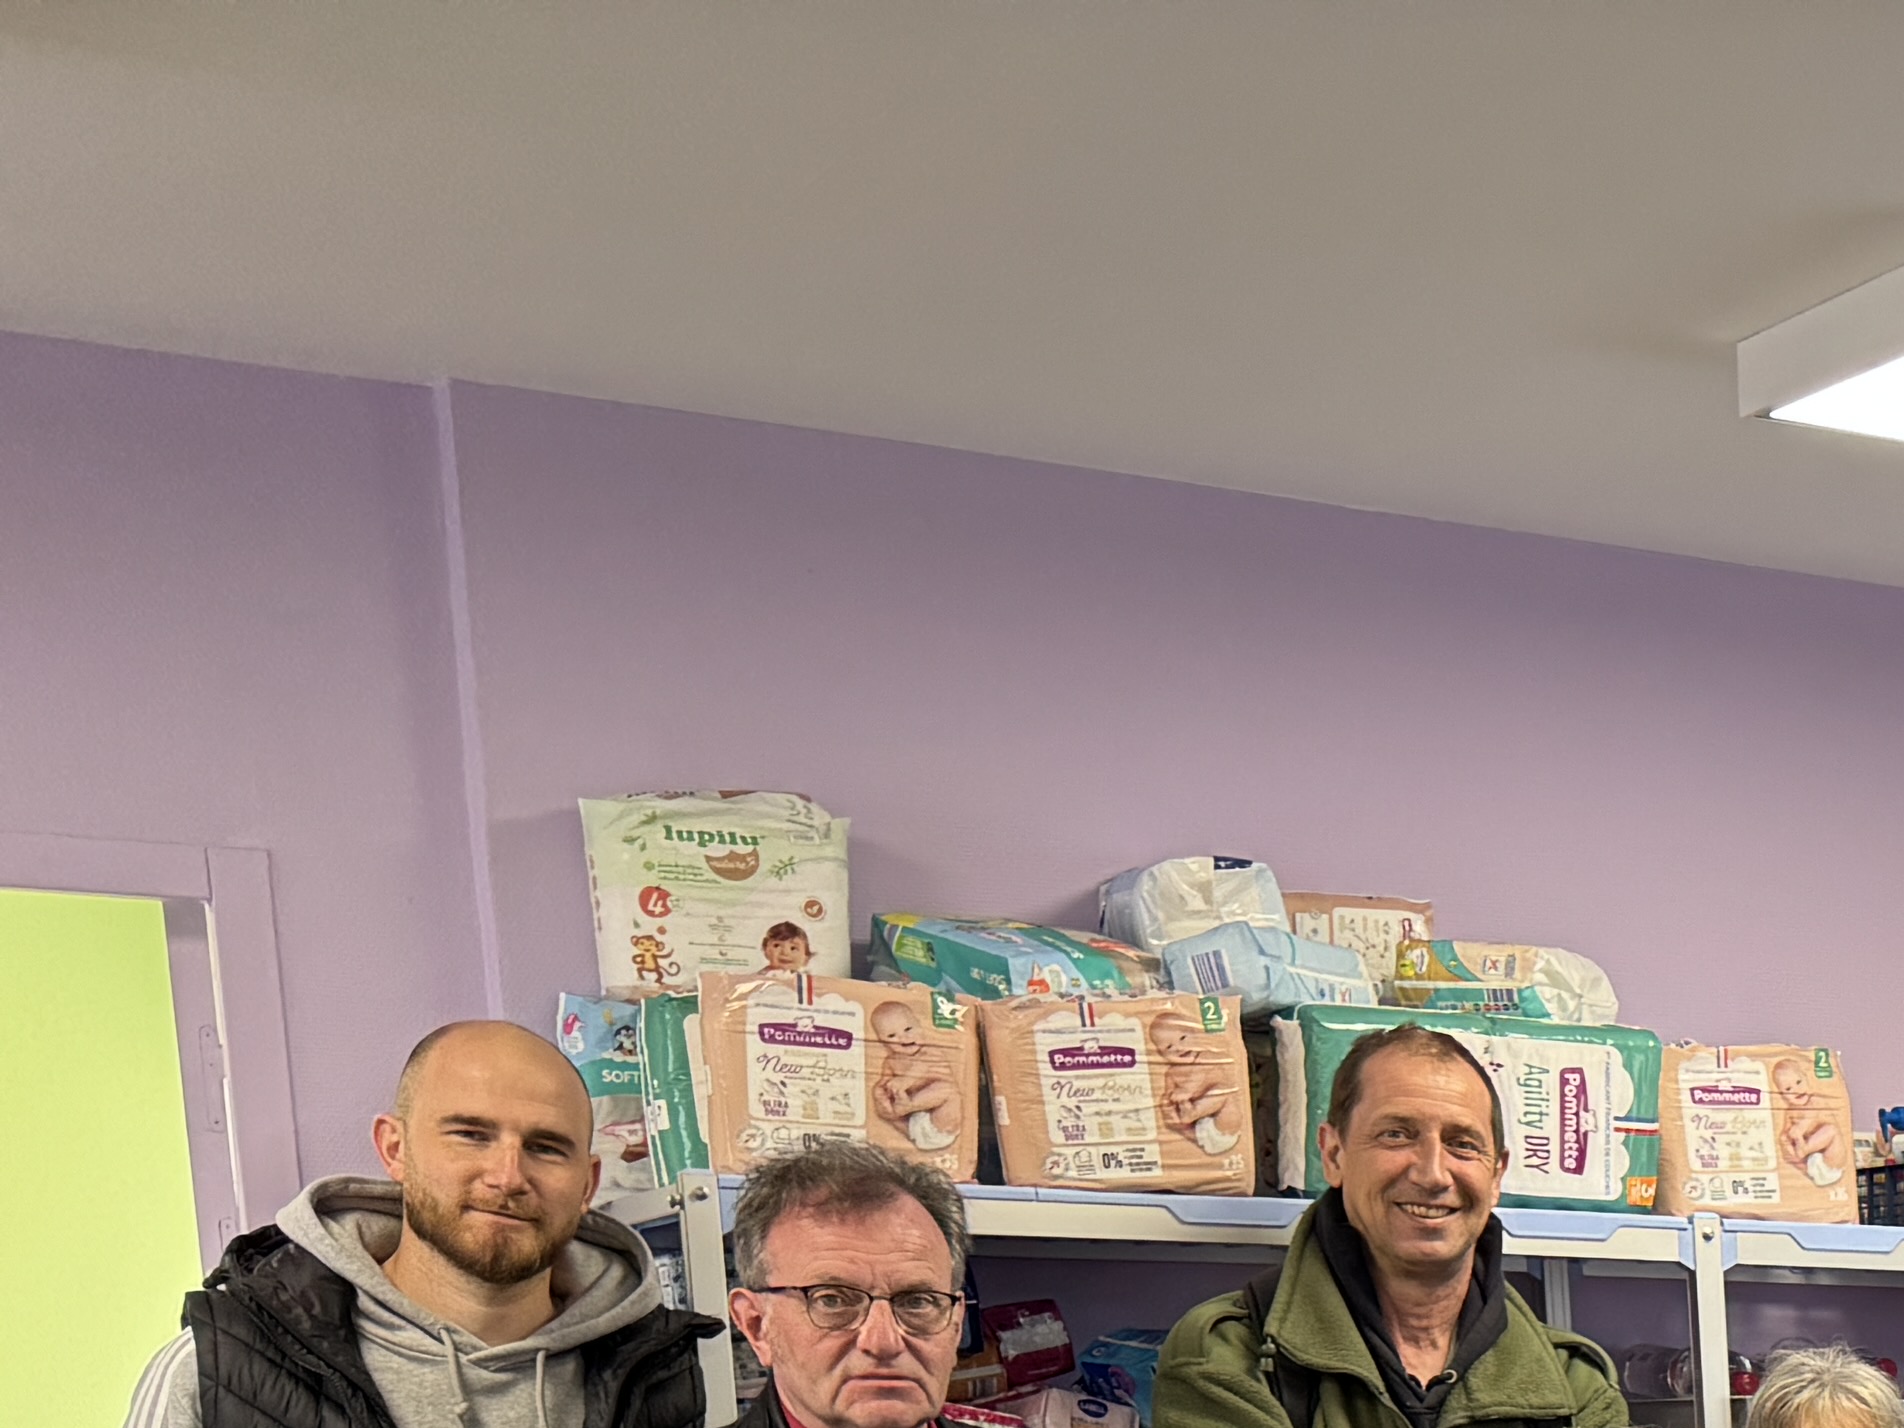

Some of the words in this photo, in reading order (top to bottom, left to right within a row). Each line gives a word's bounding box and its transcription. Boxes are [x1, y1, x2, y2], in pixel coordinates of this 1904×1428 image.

[663, 824, 761, 848] lupilu
[647, 893, 665, 915] 4
[1204, 1001, 1218, 1019] 2
[757, 1053, 803, 1074] New
[1053, 1053, 1133, 1067] Pommette
[1818, 1051, 1829, 1067] 2
[601, 1069, 641, 1084] SOFT
[1051, 1080, 1095, 1099] New
[1516, 1063, 1550, 1131] Agility
[1693, 1089, 1758, 1103] Pommette
[1564, 1072, 1581, 1170] Pommette
[1102, 1152, 1124, 1170] 0%
[1523, 1135, 1550, 1175] DRY
